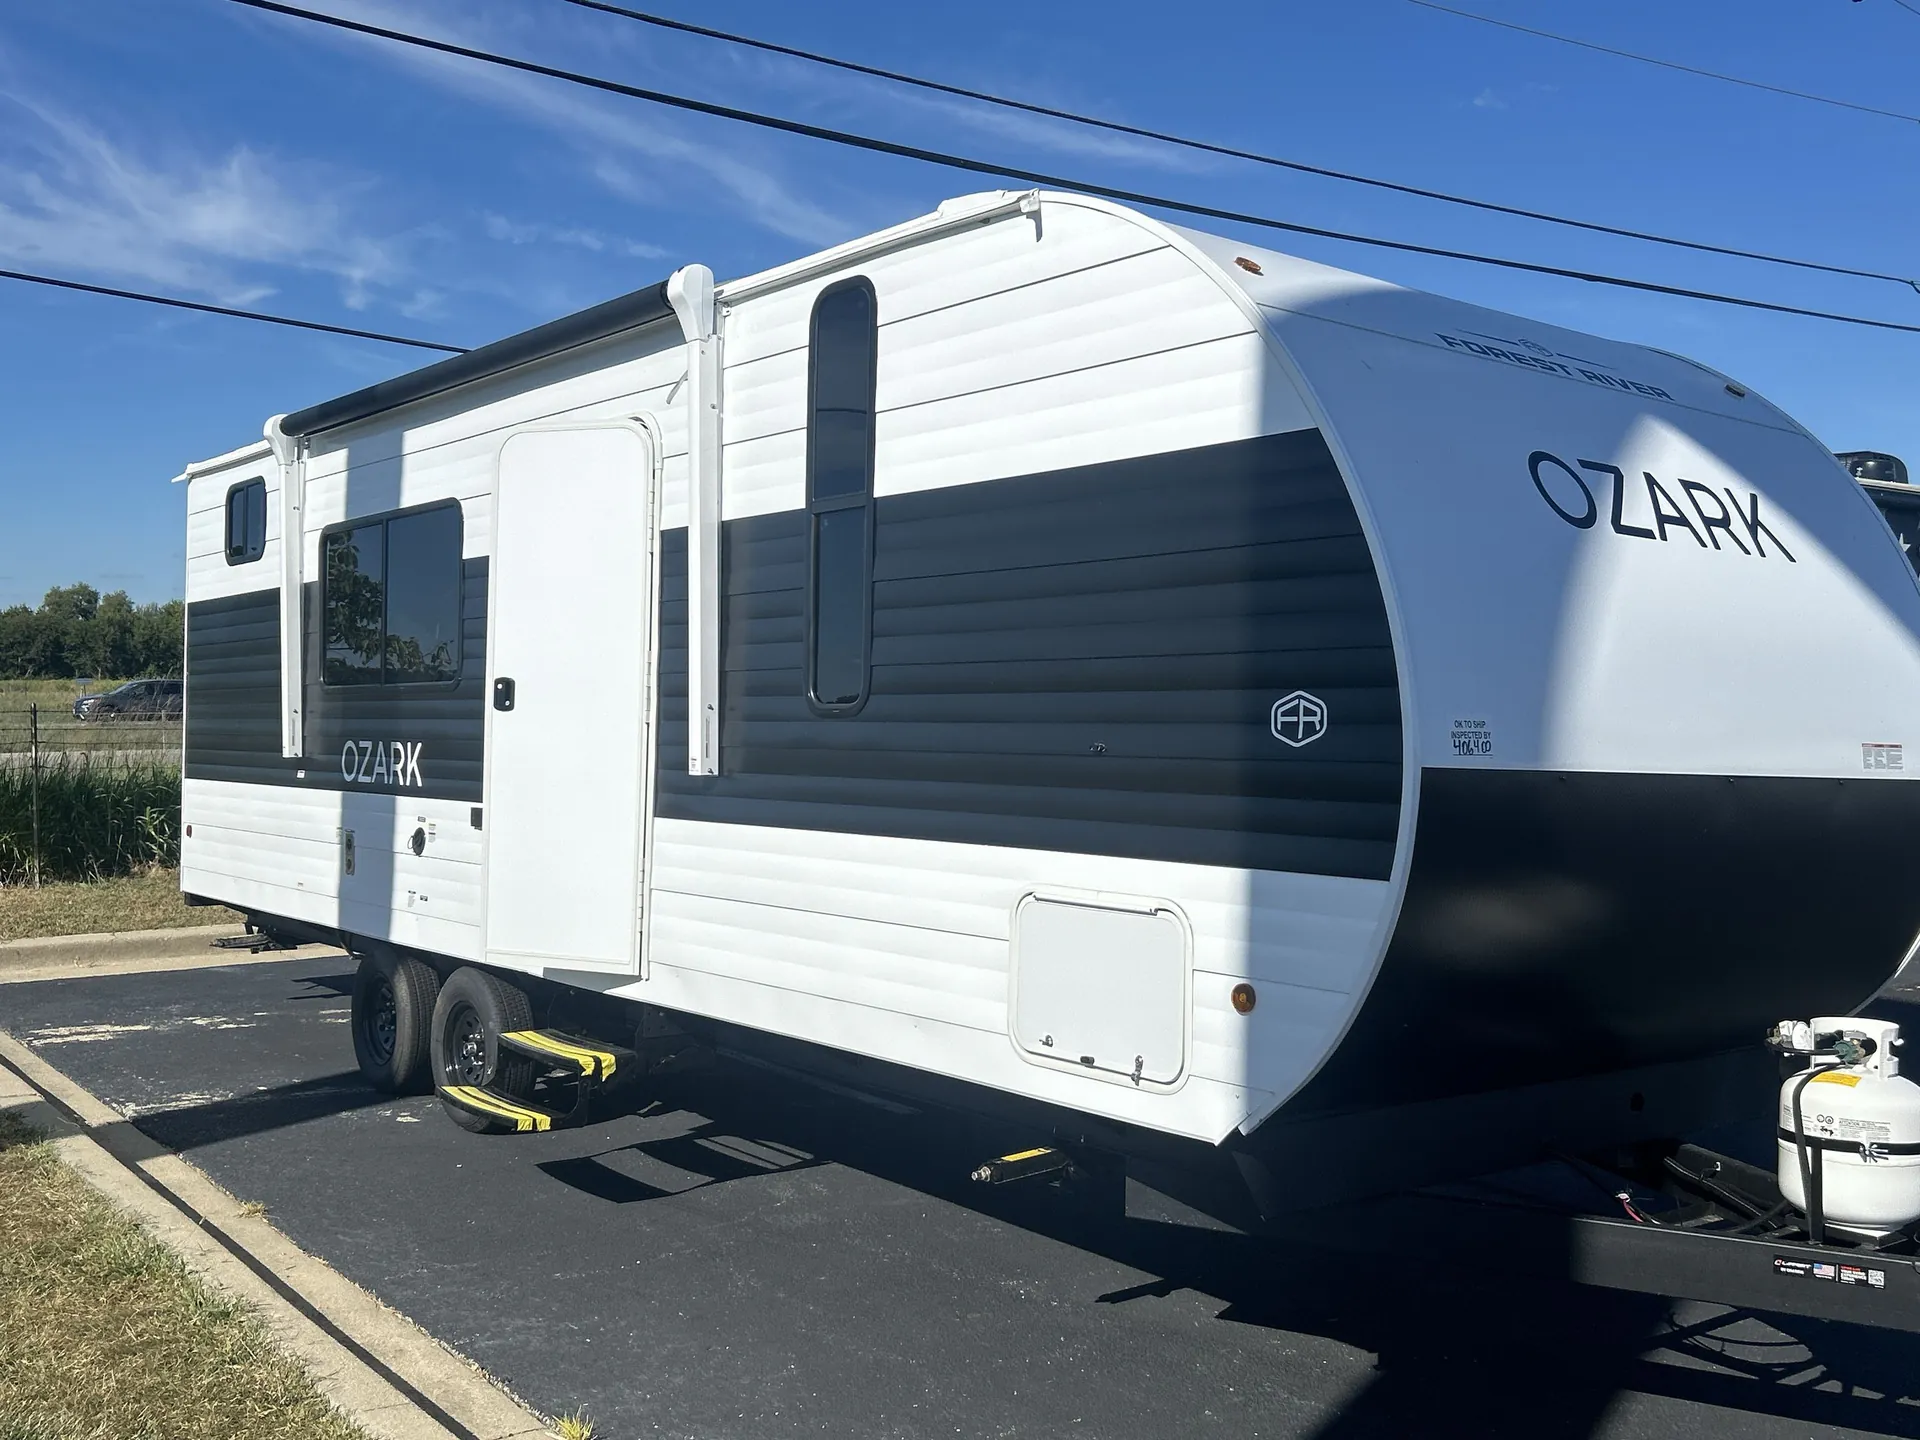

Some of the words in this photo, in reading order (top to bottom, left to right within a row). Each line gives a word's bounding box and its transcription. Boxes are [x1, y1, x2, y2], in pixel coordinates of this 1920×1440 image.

[1434, 332, 1572, 377] FOREST
[1575, 367, 1676, 401] RIVER
[1527, 450, 1797, 563] OZARK
[1451, 731, 1483, 739] INSPECTED
[1484, 731, 1491, 739] BY
[1454, 720, 1463, 729] OK
[1463, 720, 1472, 729] TO
[1473, 721, 1486, 729] SHIP
[341, 740, 423, 788] OZARK
